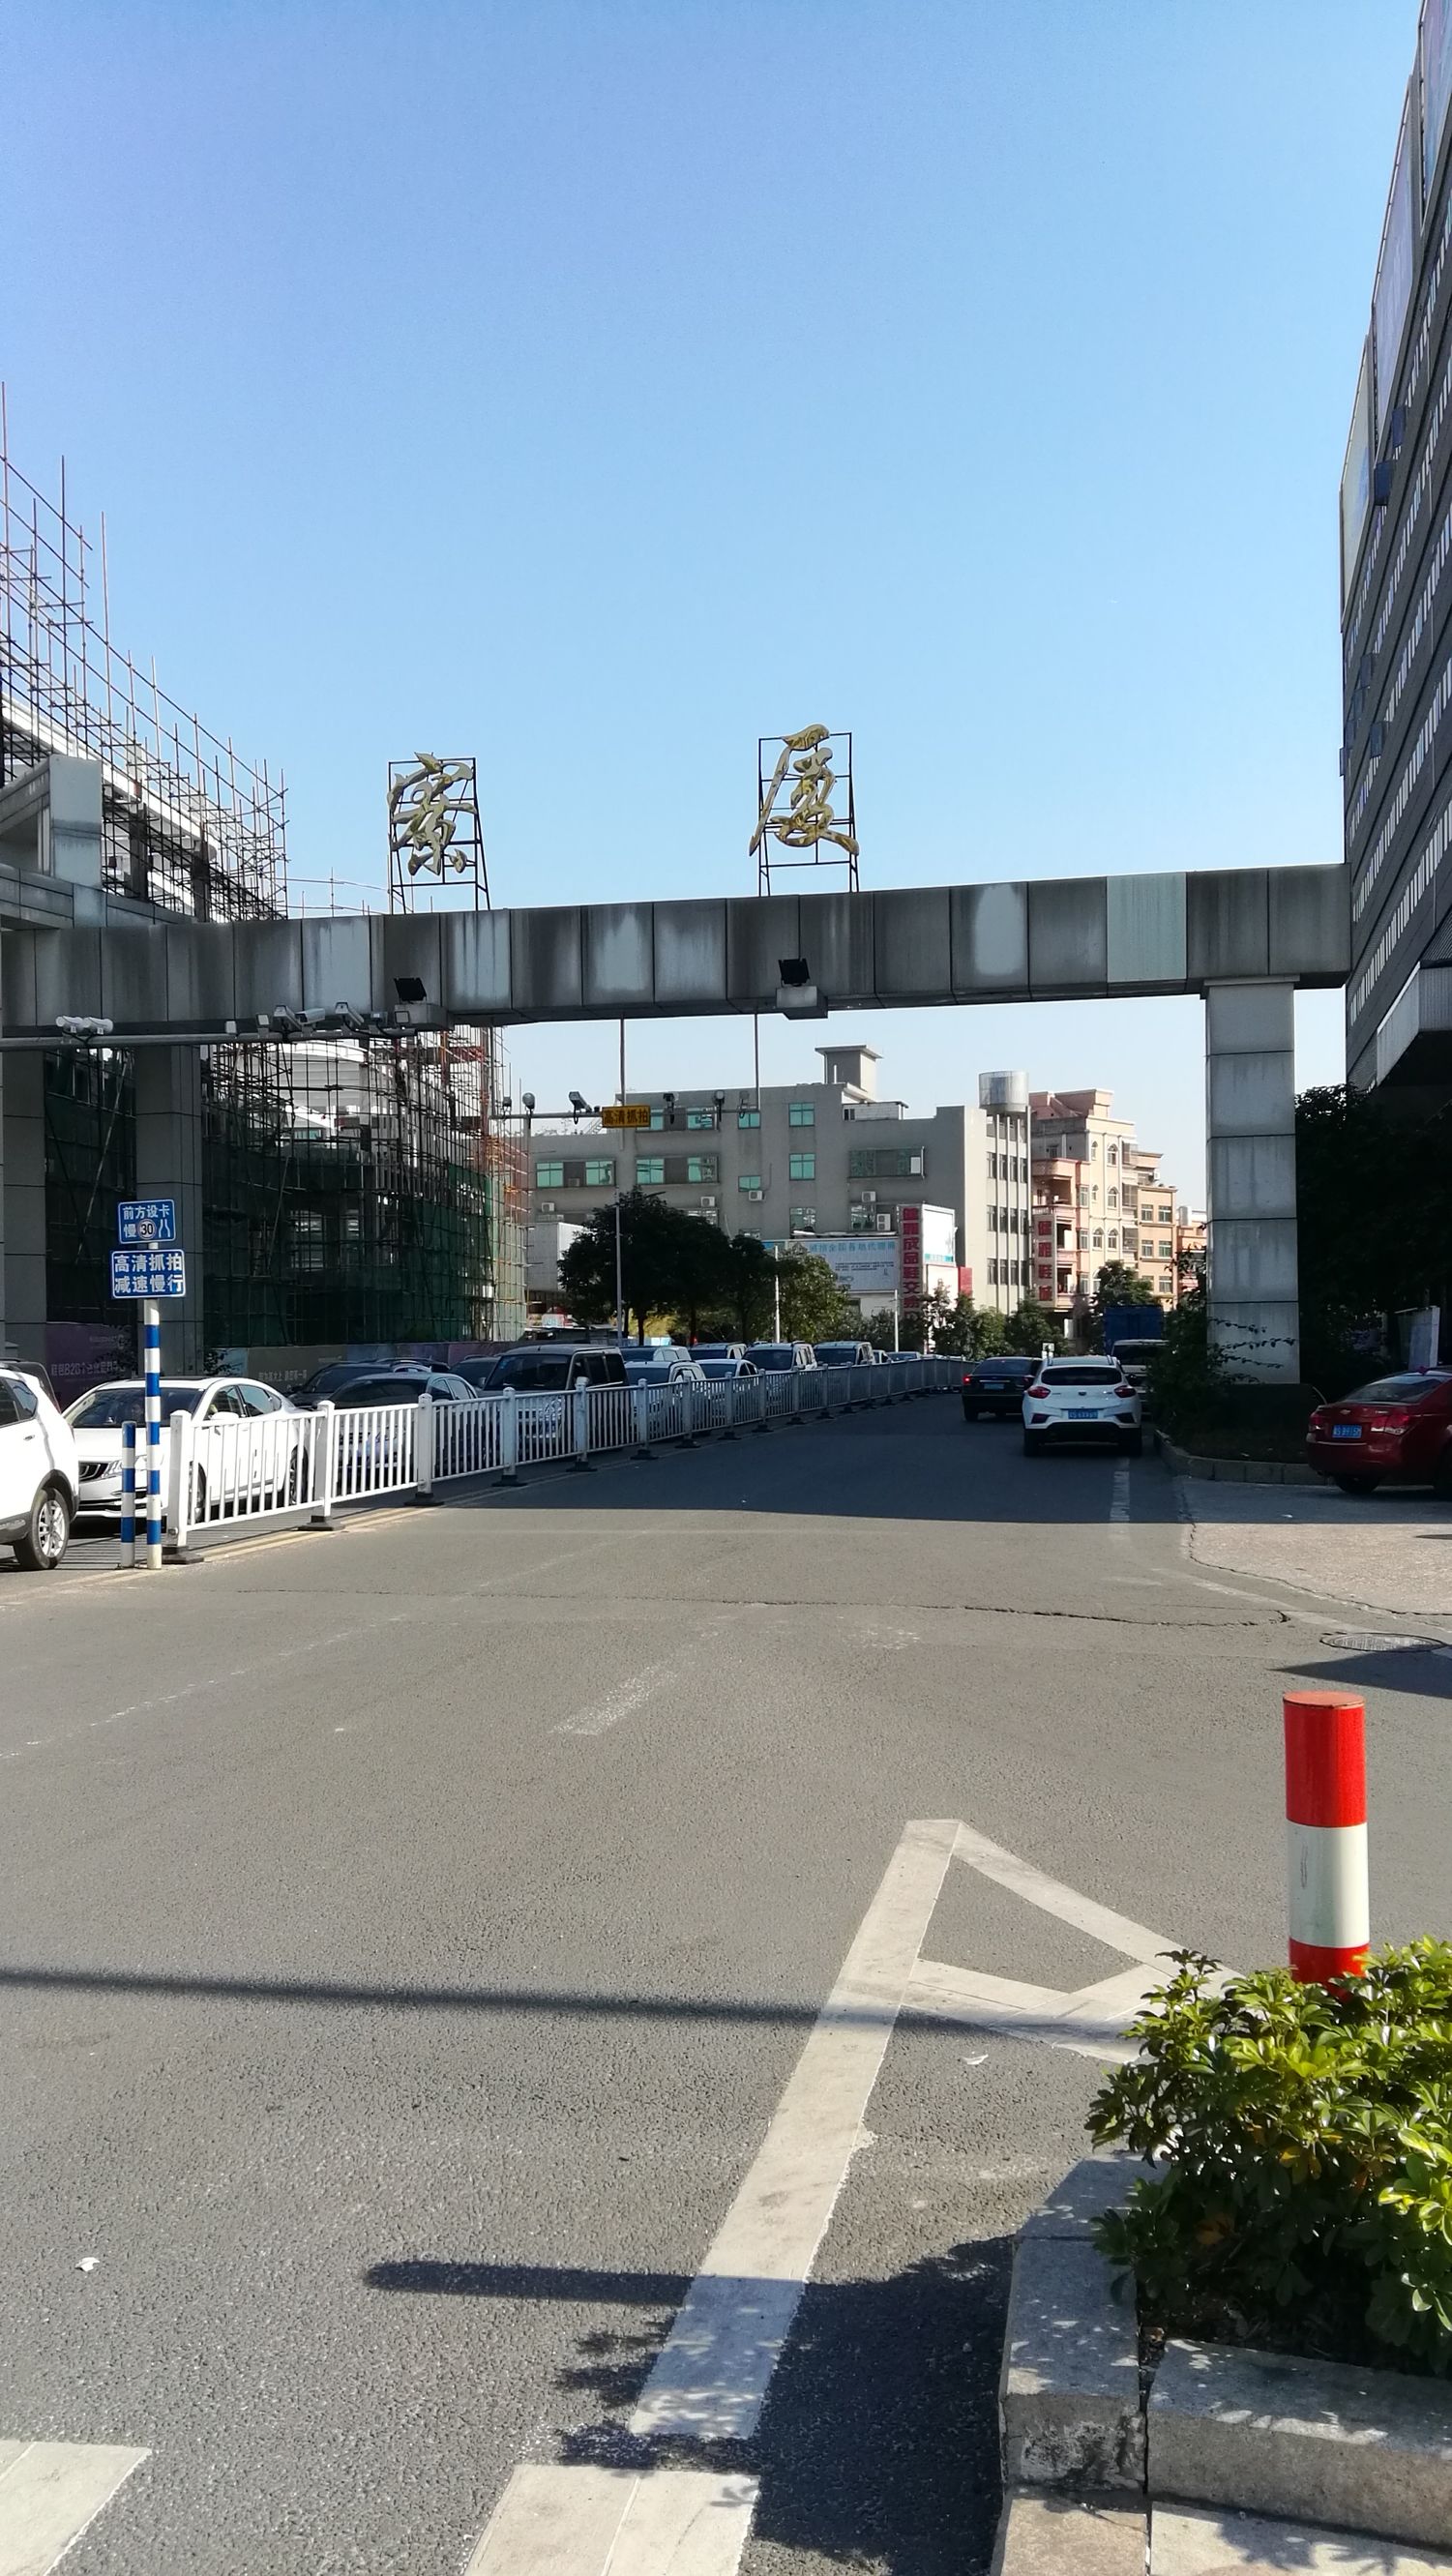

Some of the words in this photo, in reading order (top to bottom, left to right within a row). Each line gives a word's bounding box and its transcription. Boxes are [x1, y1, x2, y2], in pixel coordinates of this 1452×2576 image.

[604, 1108, 648, 1125] 高清抓拍
[122, 1203, 170, 1220] 前方设卡
[123, 1223, 136, 1238] 慢
[140, 1223, 154, 1235] 30
[114, 1253, 183, 1272] 高清抓拍
[114, 1274, 184, 1293] 减速慢行
